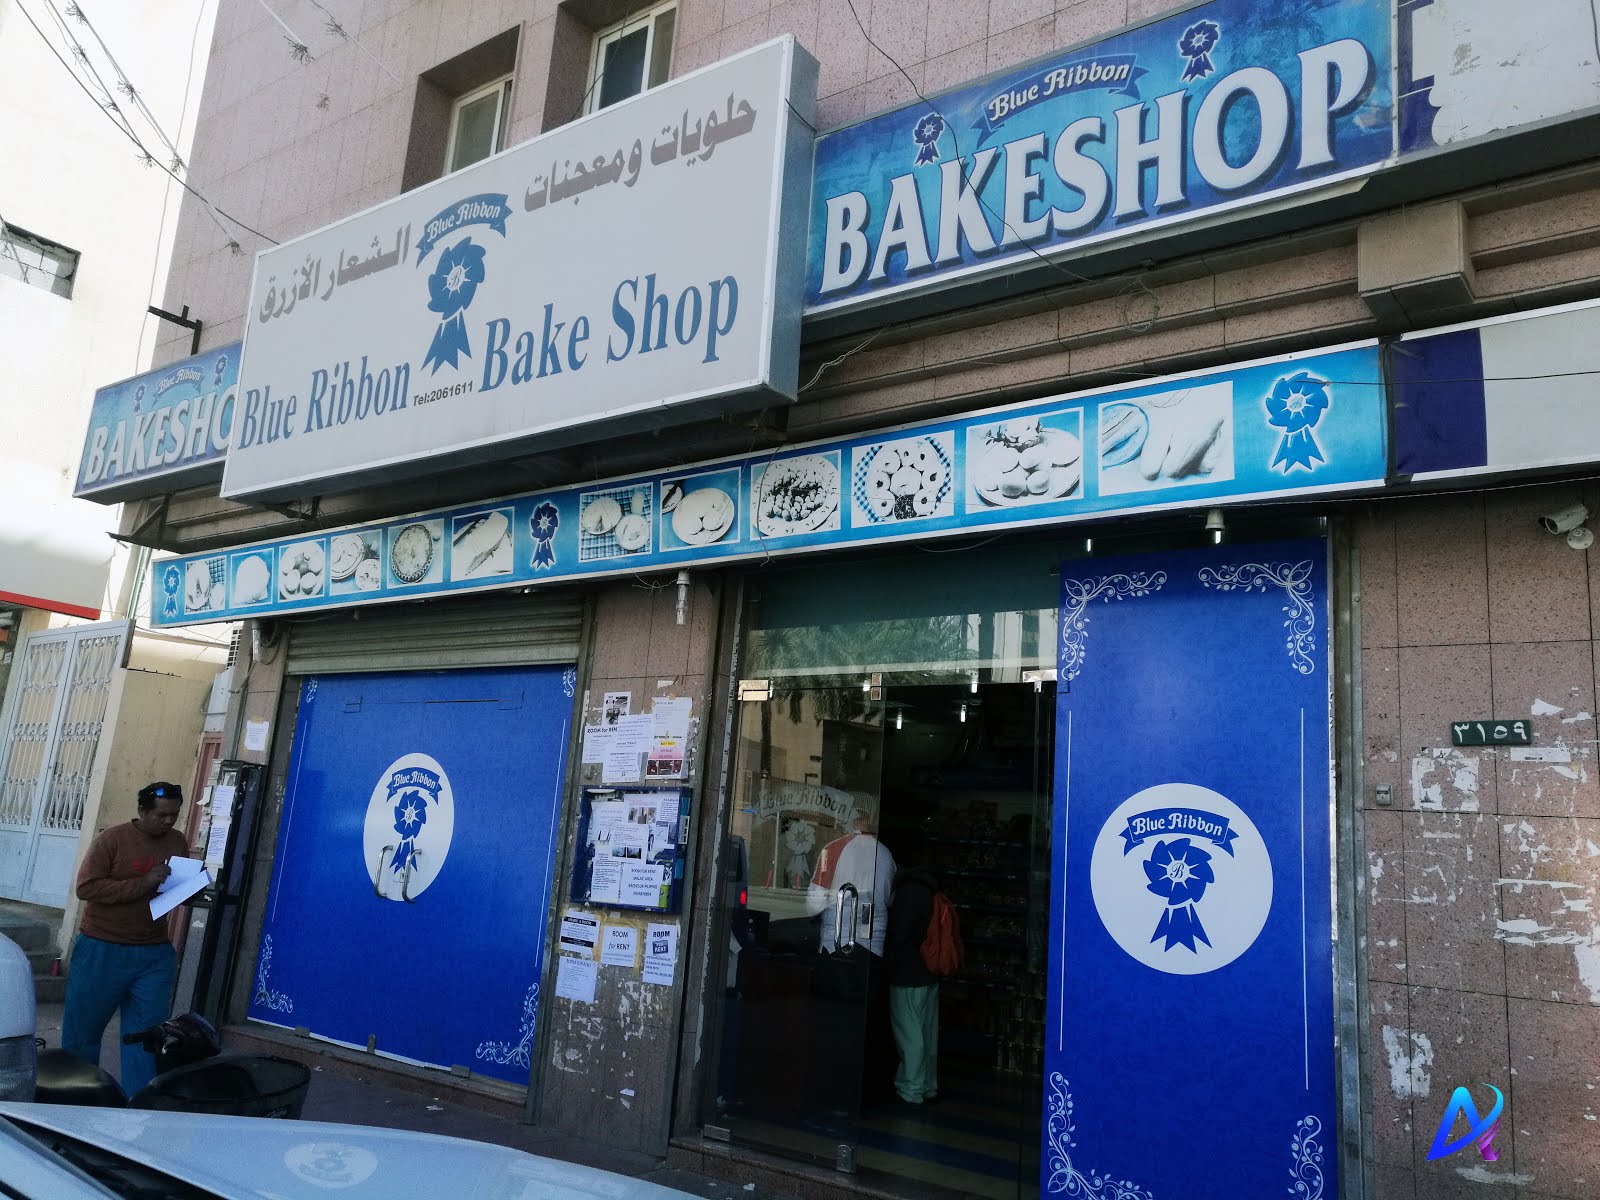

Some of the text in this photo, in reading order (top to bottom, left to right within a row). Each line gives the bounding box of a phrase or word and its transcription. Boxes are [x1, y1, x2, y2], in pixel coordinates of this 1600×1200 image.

[987, 61, 1131, 123] Blue Ribbon
[524, 91, 758, 212] حلويات ومعجنات
[819, 38, 1370, 294] BAKESHOP
[426, 203, 502, 243] Blue Ribbon
[320, 222, 411, 302] الشعار
[478, 273, 739, 393] Bake Shop
[158, 368, 201, 393] Blue Ribbon
[238, 355, 411, 450] Blue Ribbon
[413, 380, 474, 407] Tel:2061611
[83, 384, 237, 484] BAKESHO
[393, 770, 436, 790] Blue Ribbon
[1131, 812, 1223, 837] Blue Ribbon
[612, 930, 628, 938] ROOM
[652, 930, 671, 938] ROOM
